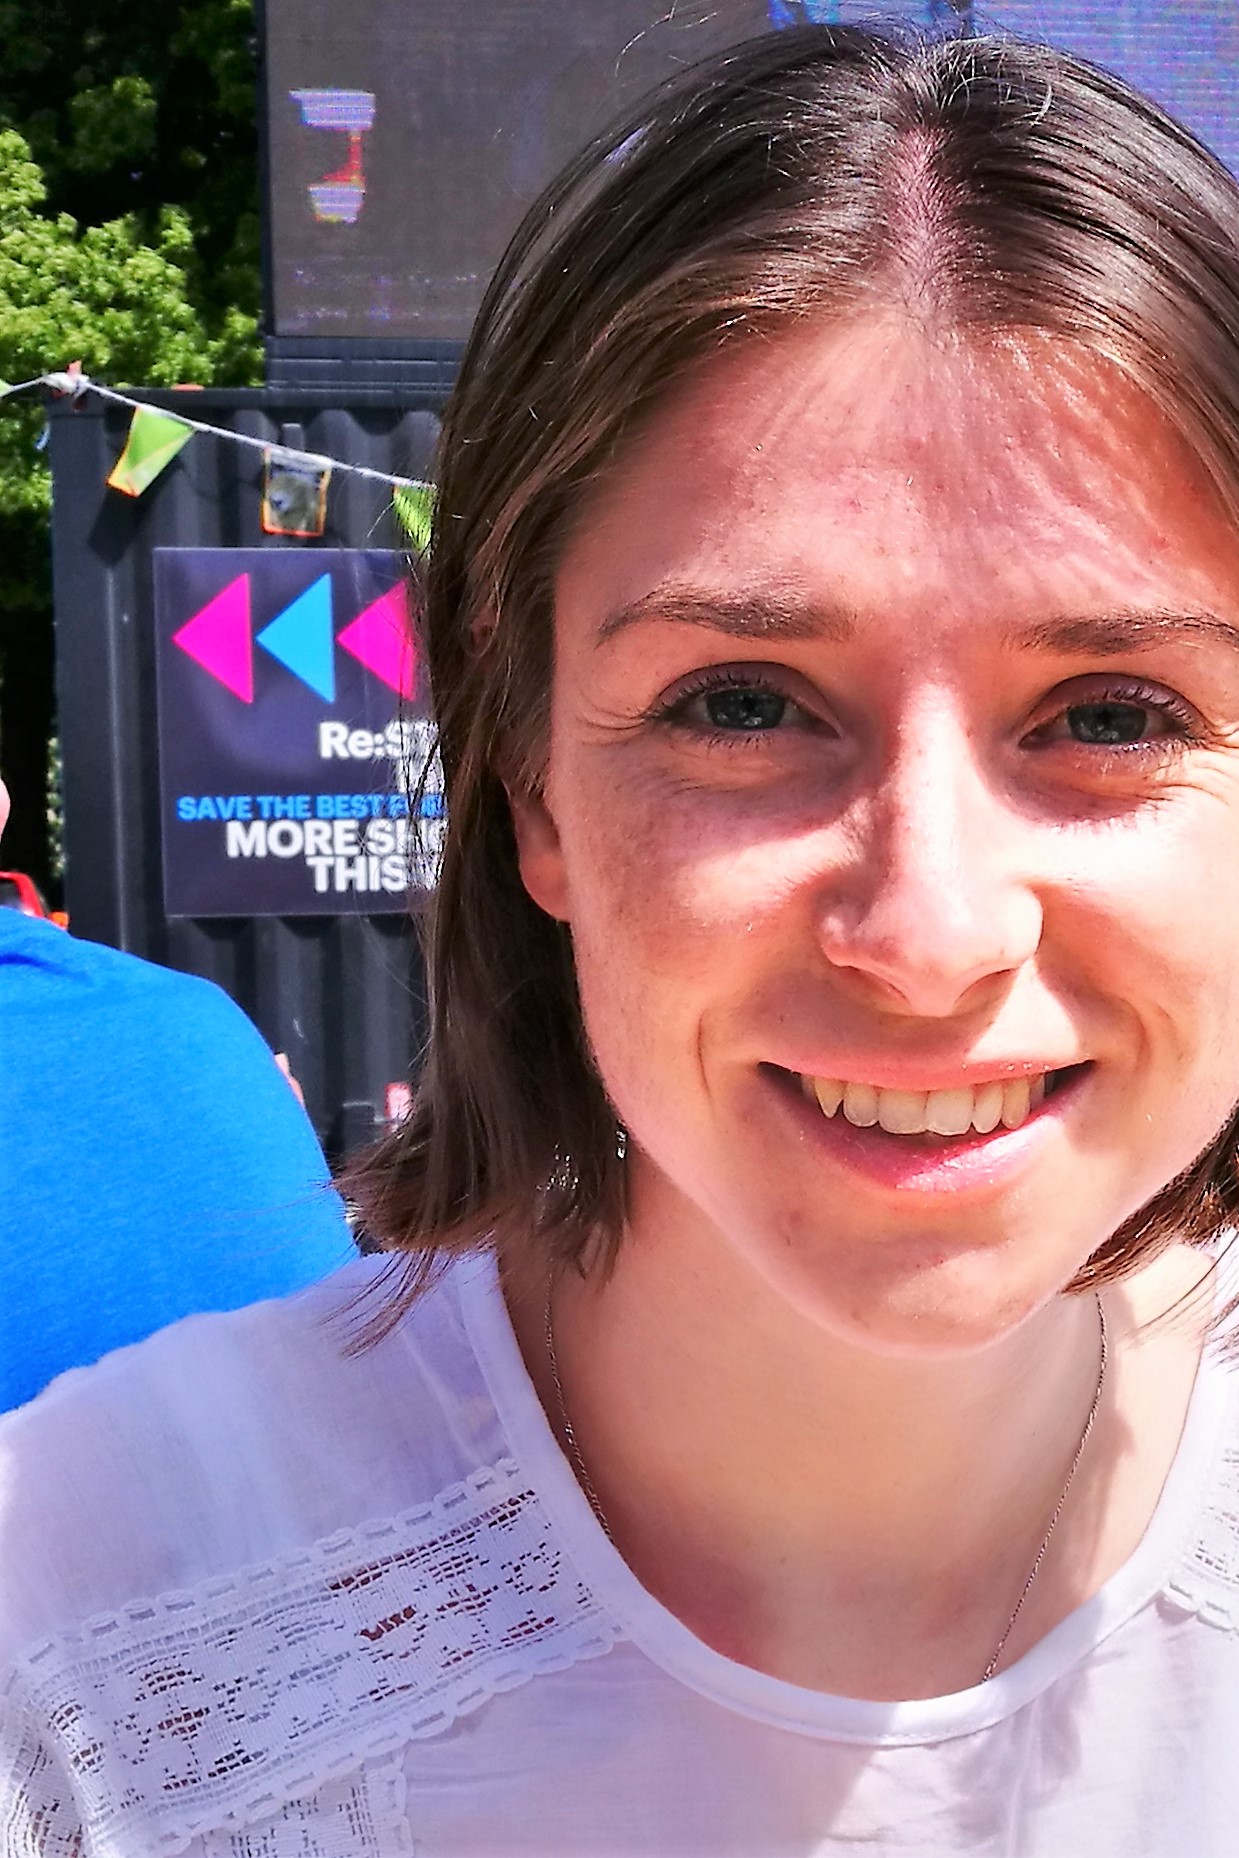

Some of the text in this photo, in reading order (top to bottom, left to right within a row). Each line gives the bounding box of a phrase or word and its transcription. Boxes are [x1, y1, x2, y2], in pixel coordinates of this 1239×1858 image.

[177, 794, 252, 821] SAVE
[256, 794, 312, 820] THE
[316, 793, 384, 820] BEST
[226, 818, 361, 858] MORE
[305, 854, 408, 893] THIS
